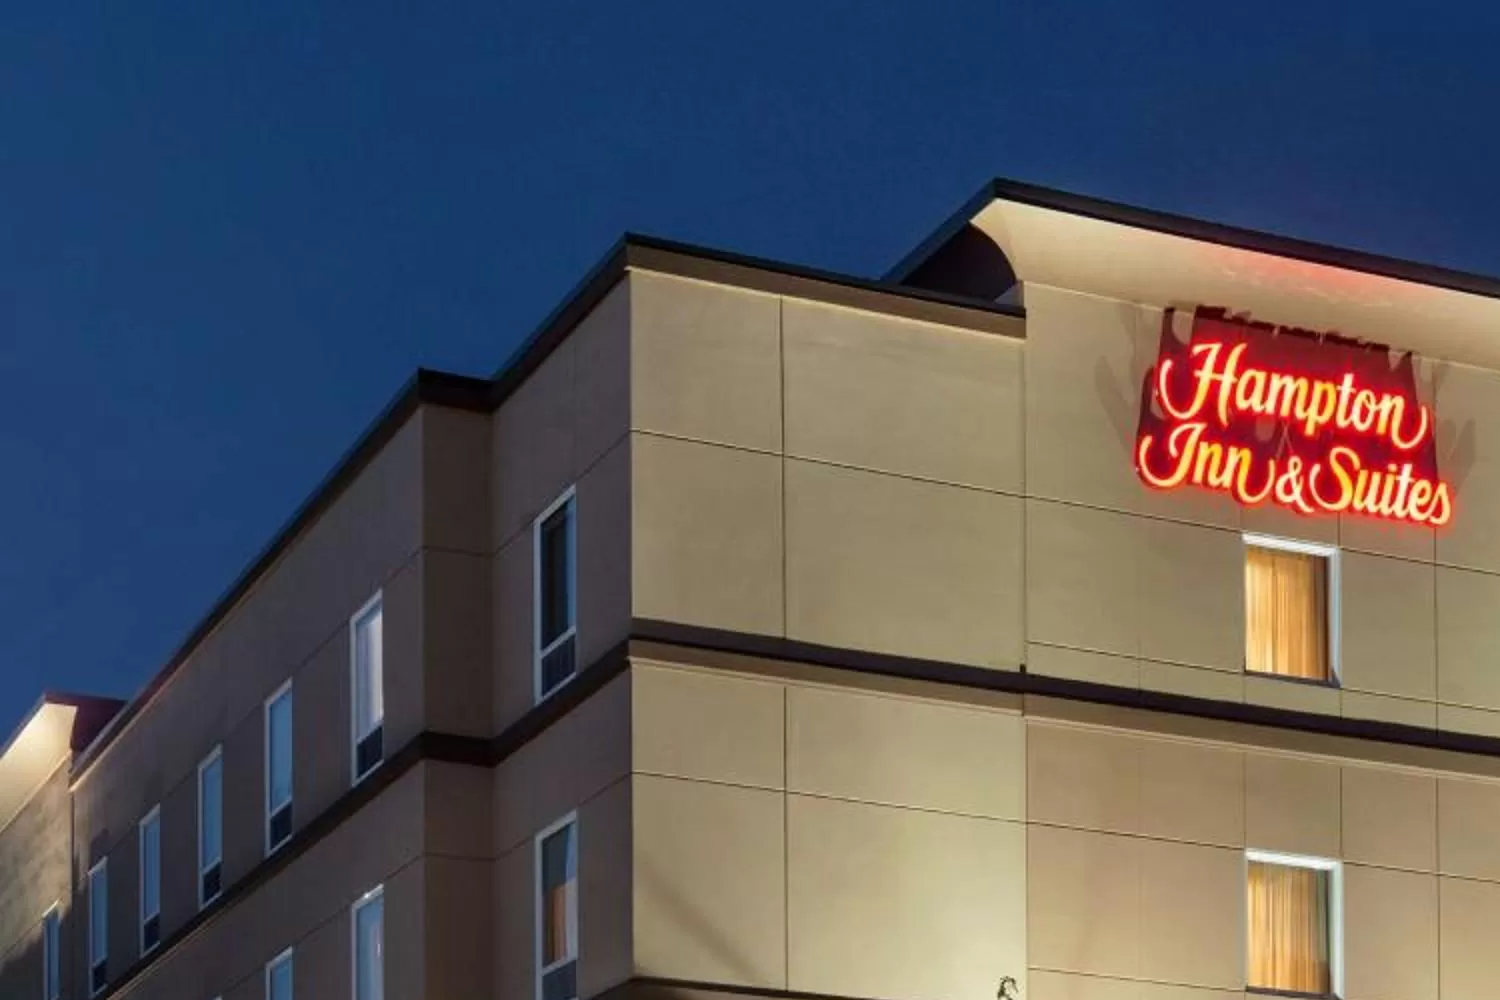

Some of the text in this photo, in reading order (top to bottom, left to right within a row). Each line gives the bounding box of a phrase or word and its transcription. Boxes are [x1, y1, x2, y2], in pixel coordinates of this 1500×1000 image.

[1159, 342, 1428, 449] Hampton
[1139, 422, 1452, 526] Inn & Suites
